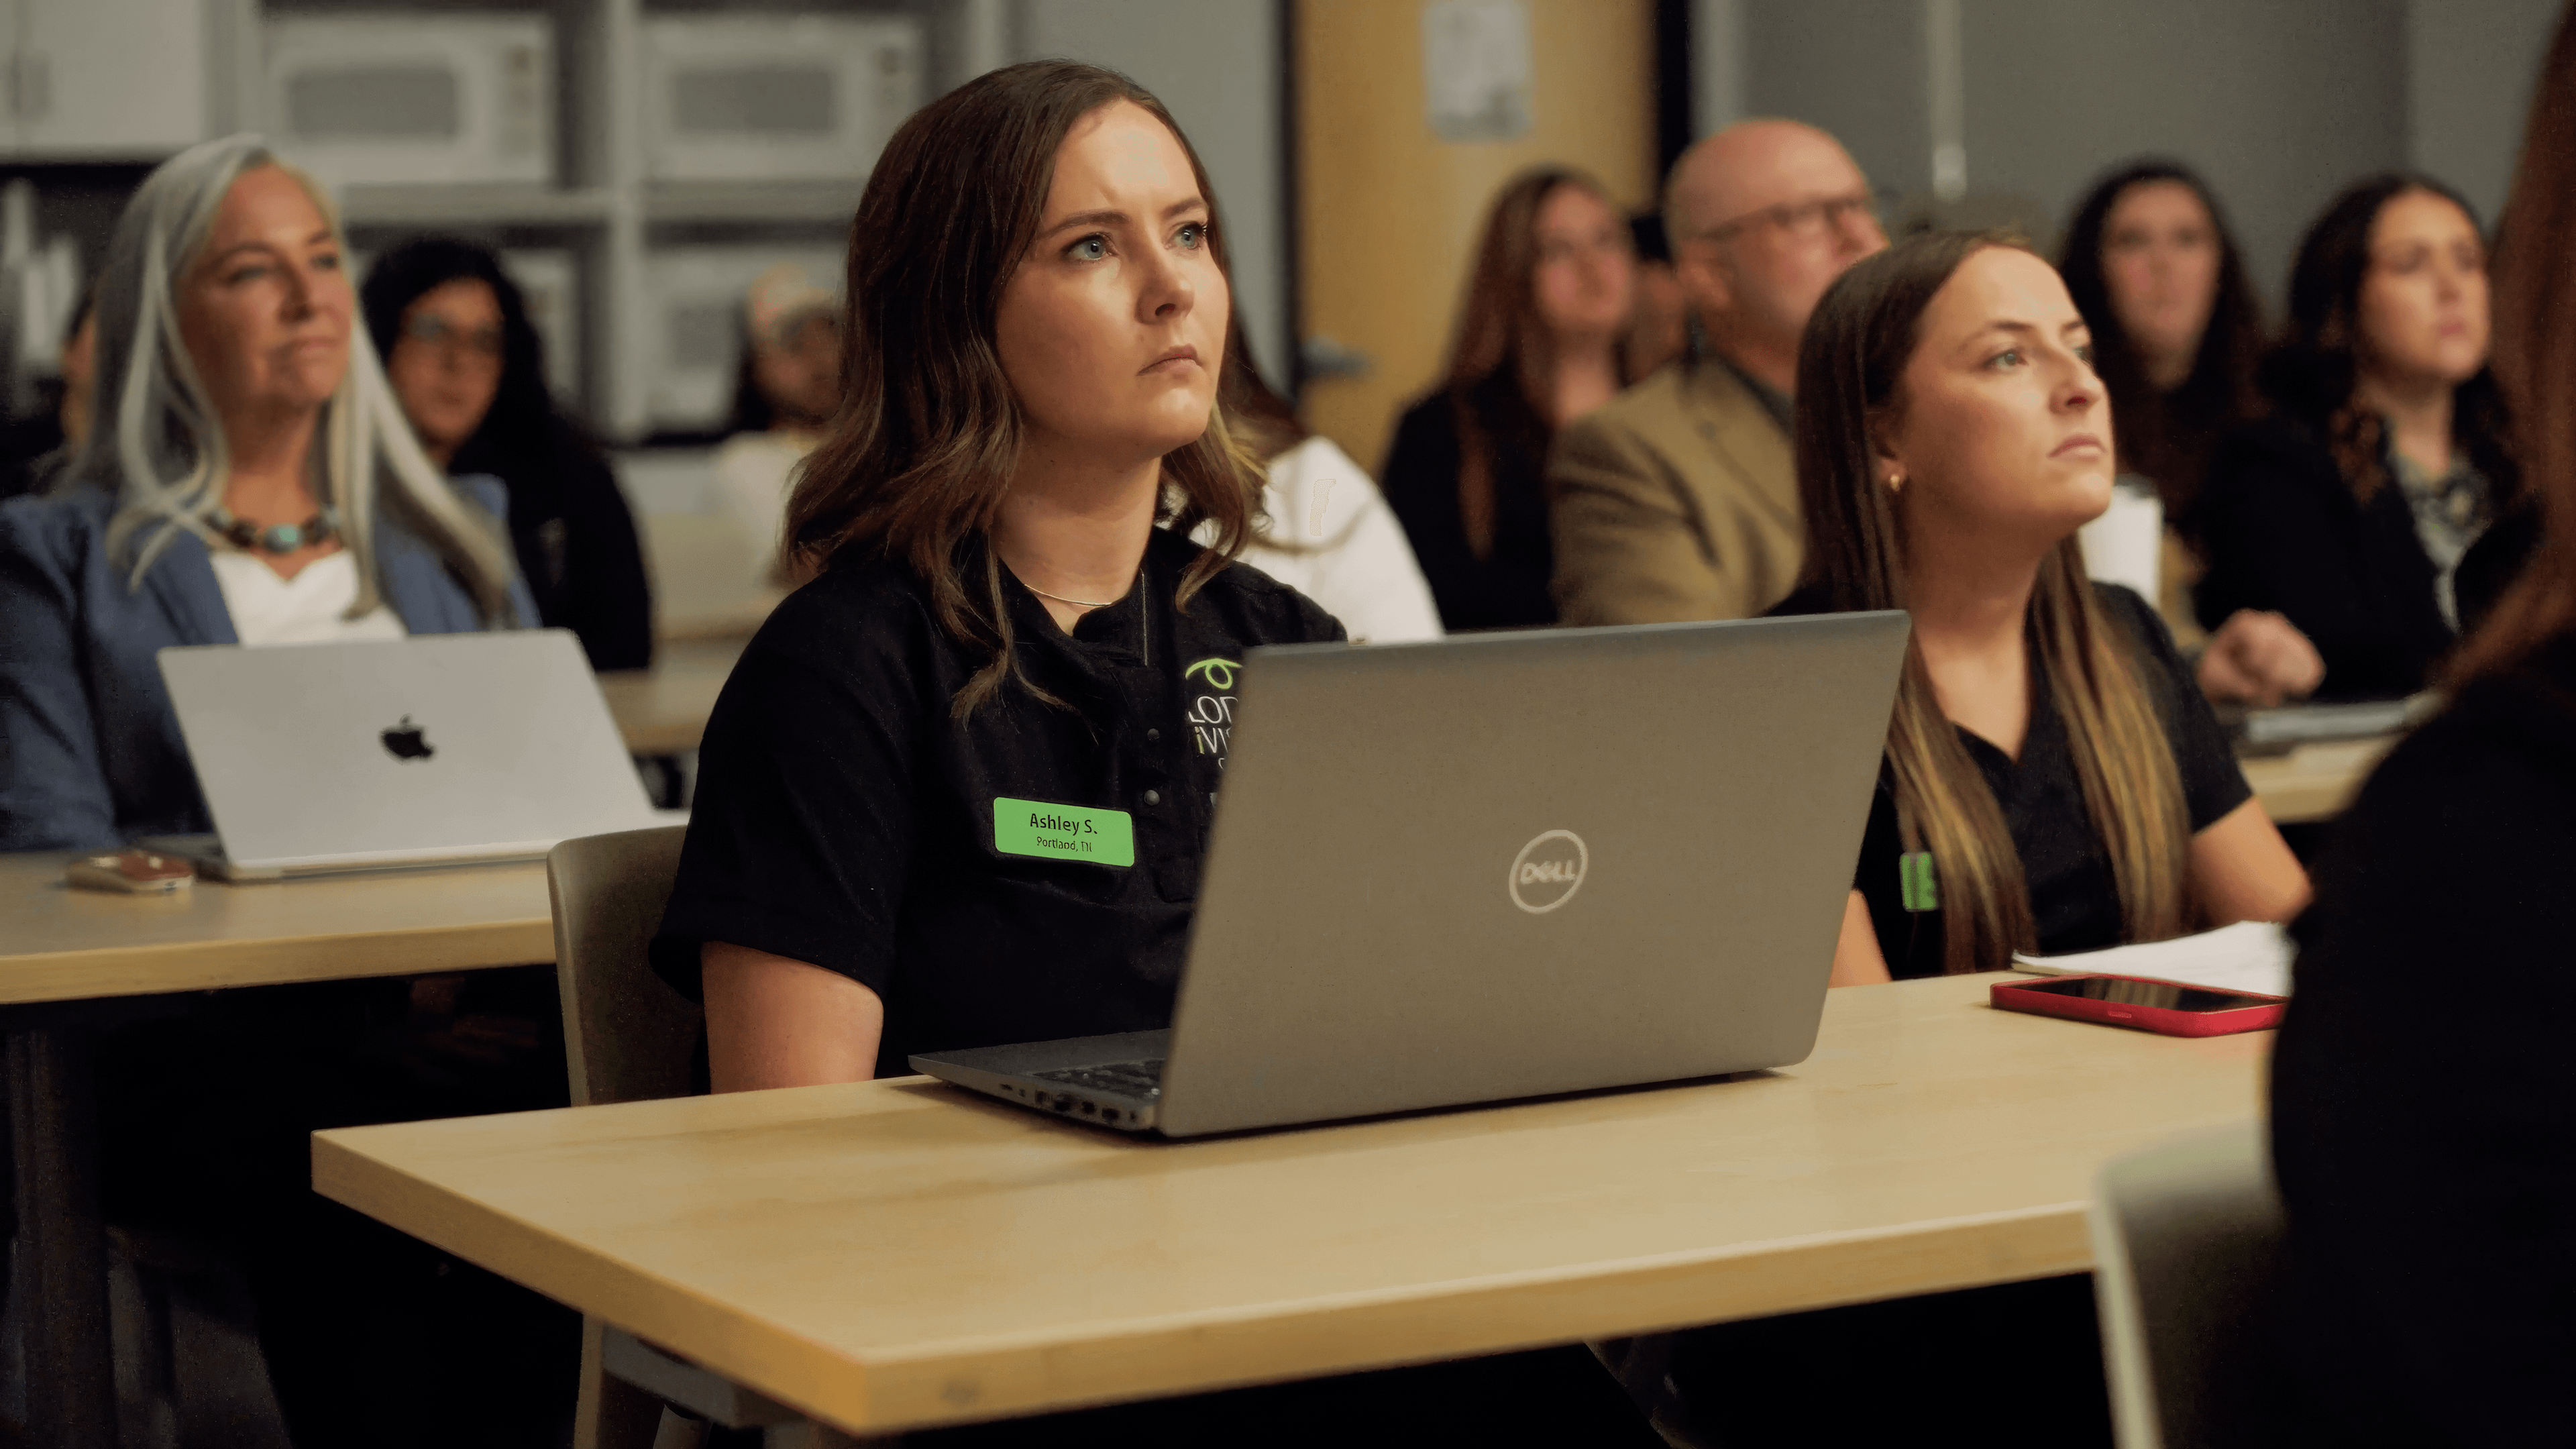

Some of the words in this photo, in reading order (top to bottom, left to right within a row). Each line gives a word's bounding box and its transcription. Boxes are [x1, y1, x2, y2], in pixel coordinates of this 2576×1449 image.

[1030, 813, 1079, 836] Ashley
[1084, 819, 1097, 835] S.
[1036, 836, 1078, 853] Portland,
[1520, 859, 1576, 885] DELL
